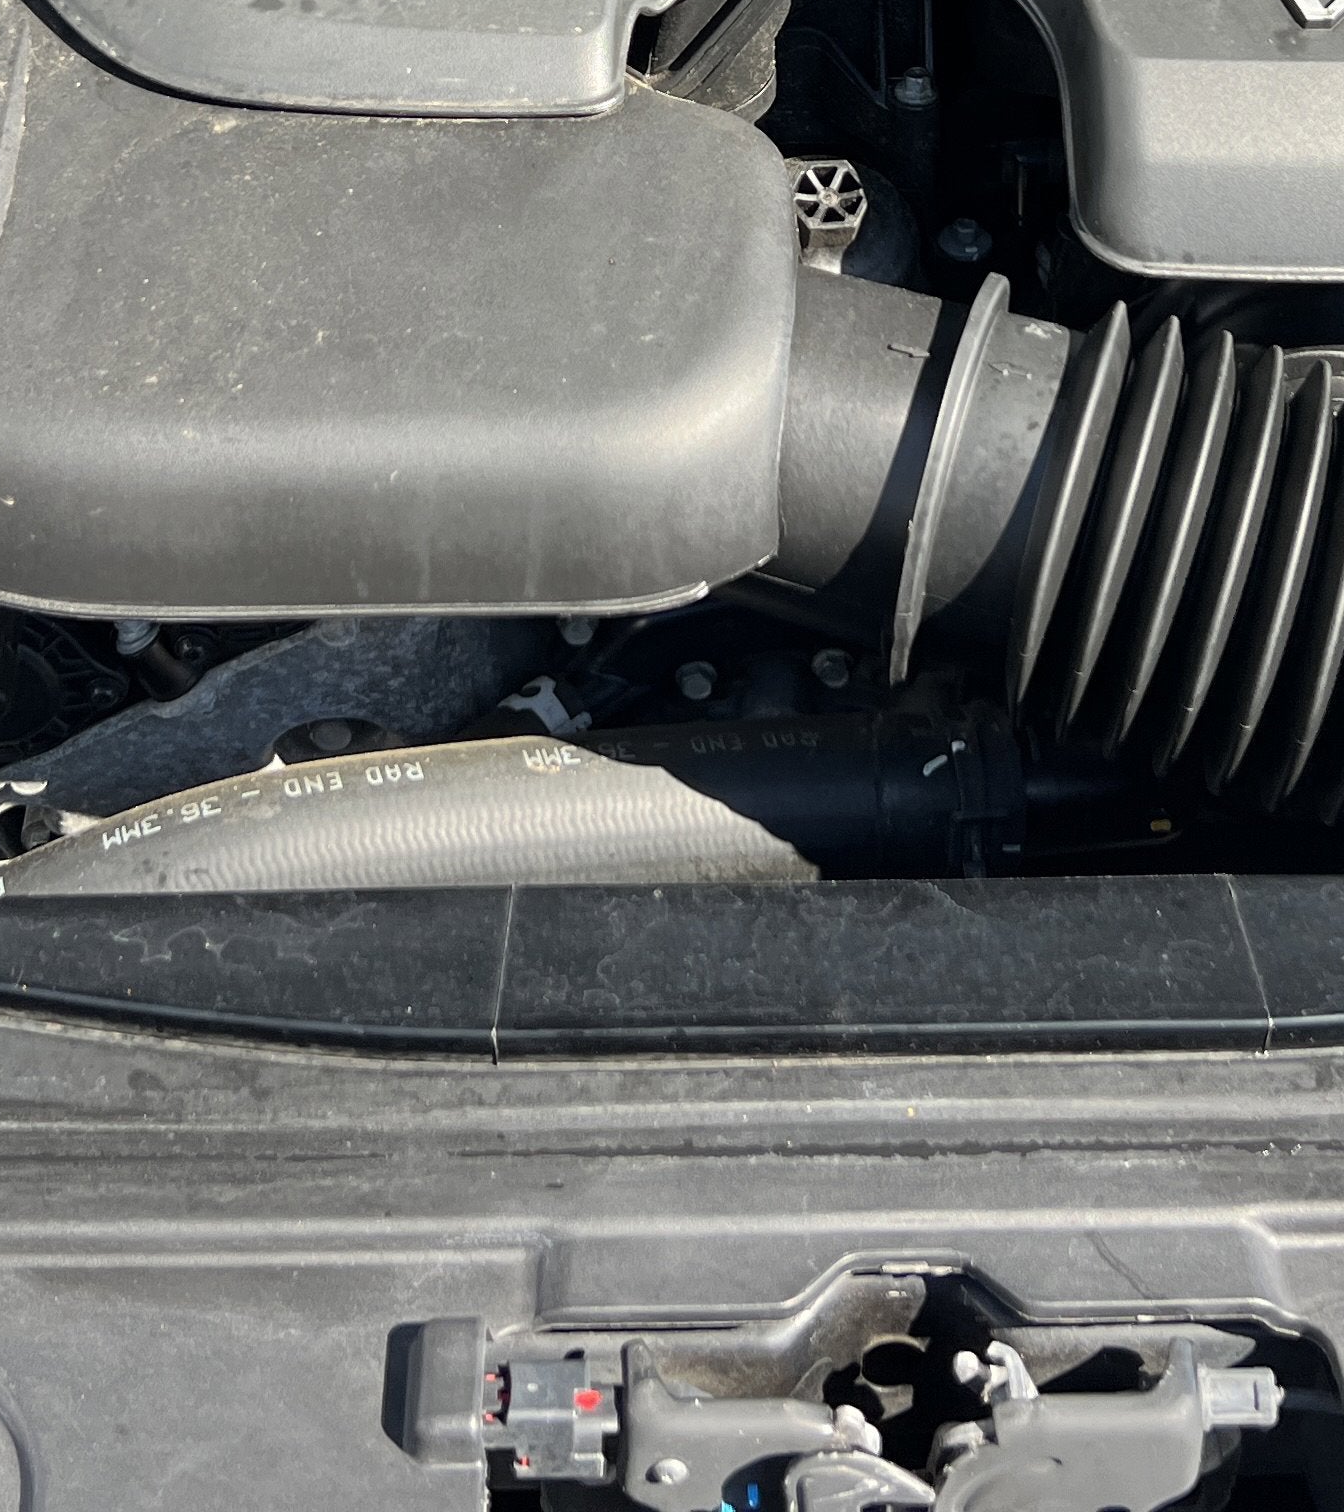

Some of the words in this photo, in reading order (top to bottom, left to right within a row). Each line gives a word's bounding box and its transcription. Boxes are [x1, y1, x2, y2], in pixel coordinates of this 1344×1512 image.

[689, 732, 742, 755] END
[281, 769, 344, 799] END
[364, 759, 424, 787] RAD
[100, 793, 222, 852] 36.3MM
